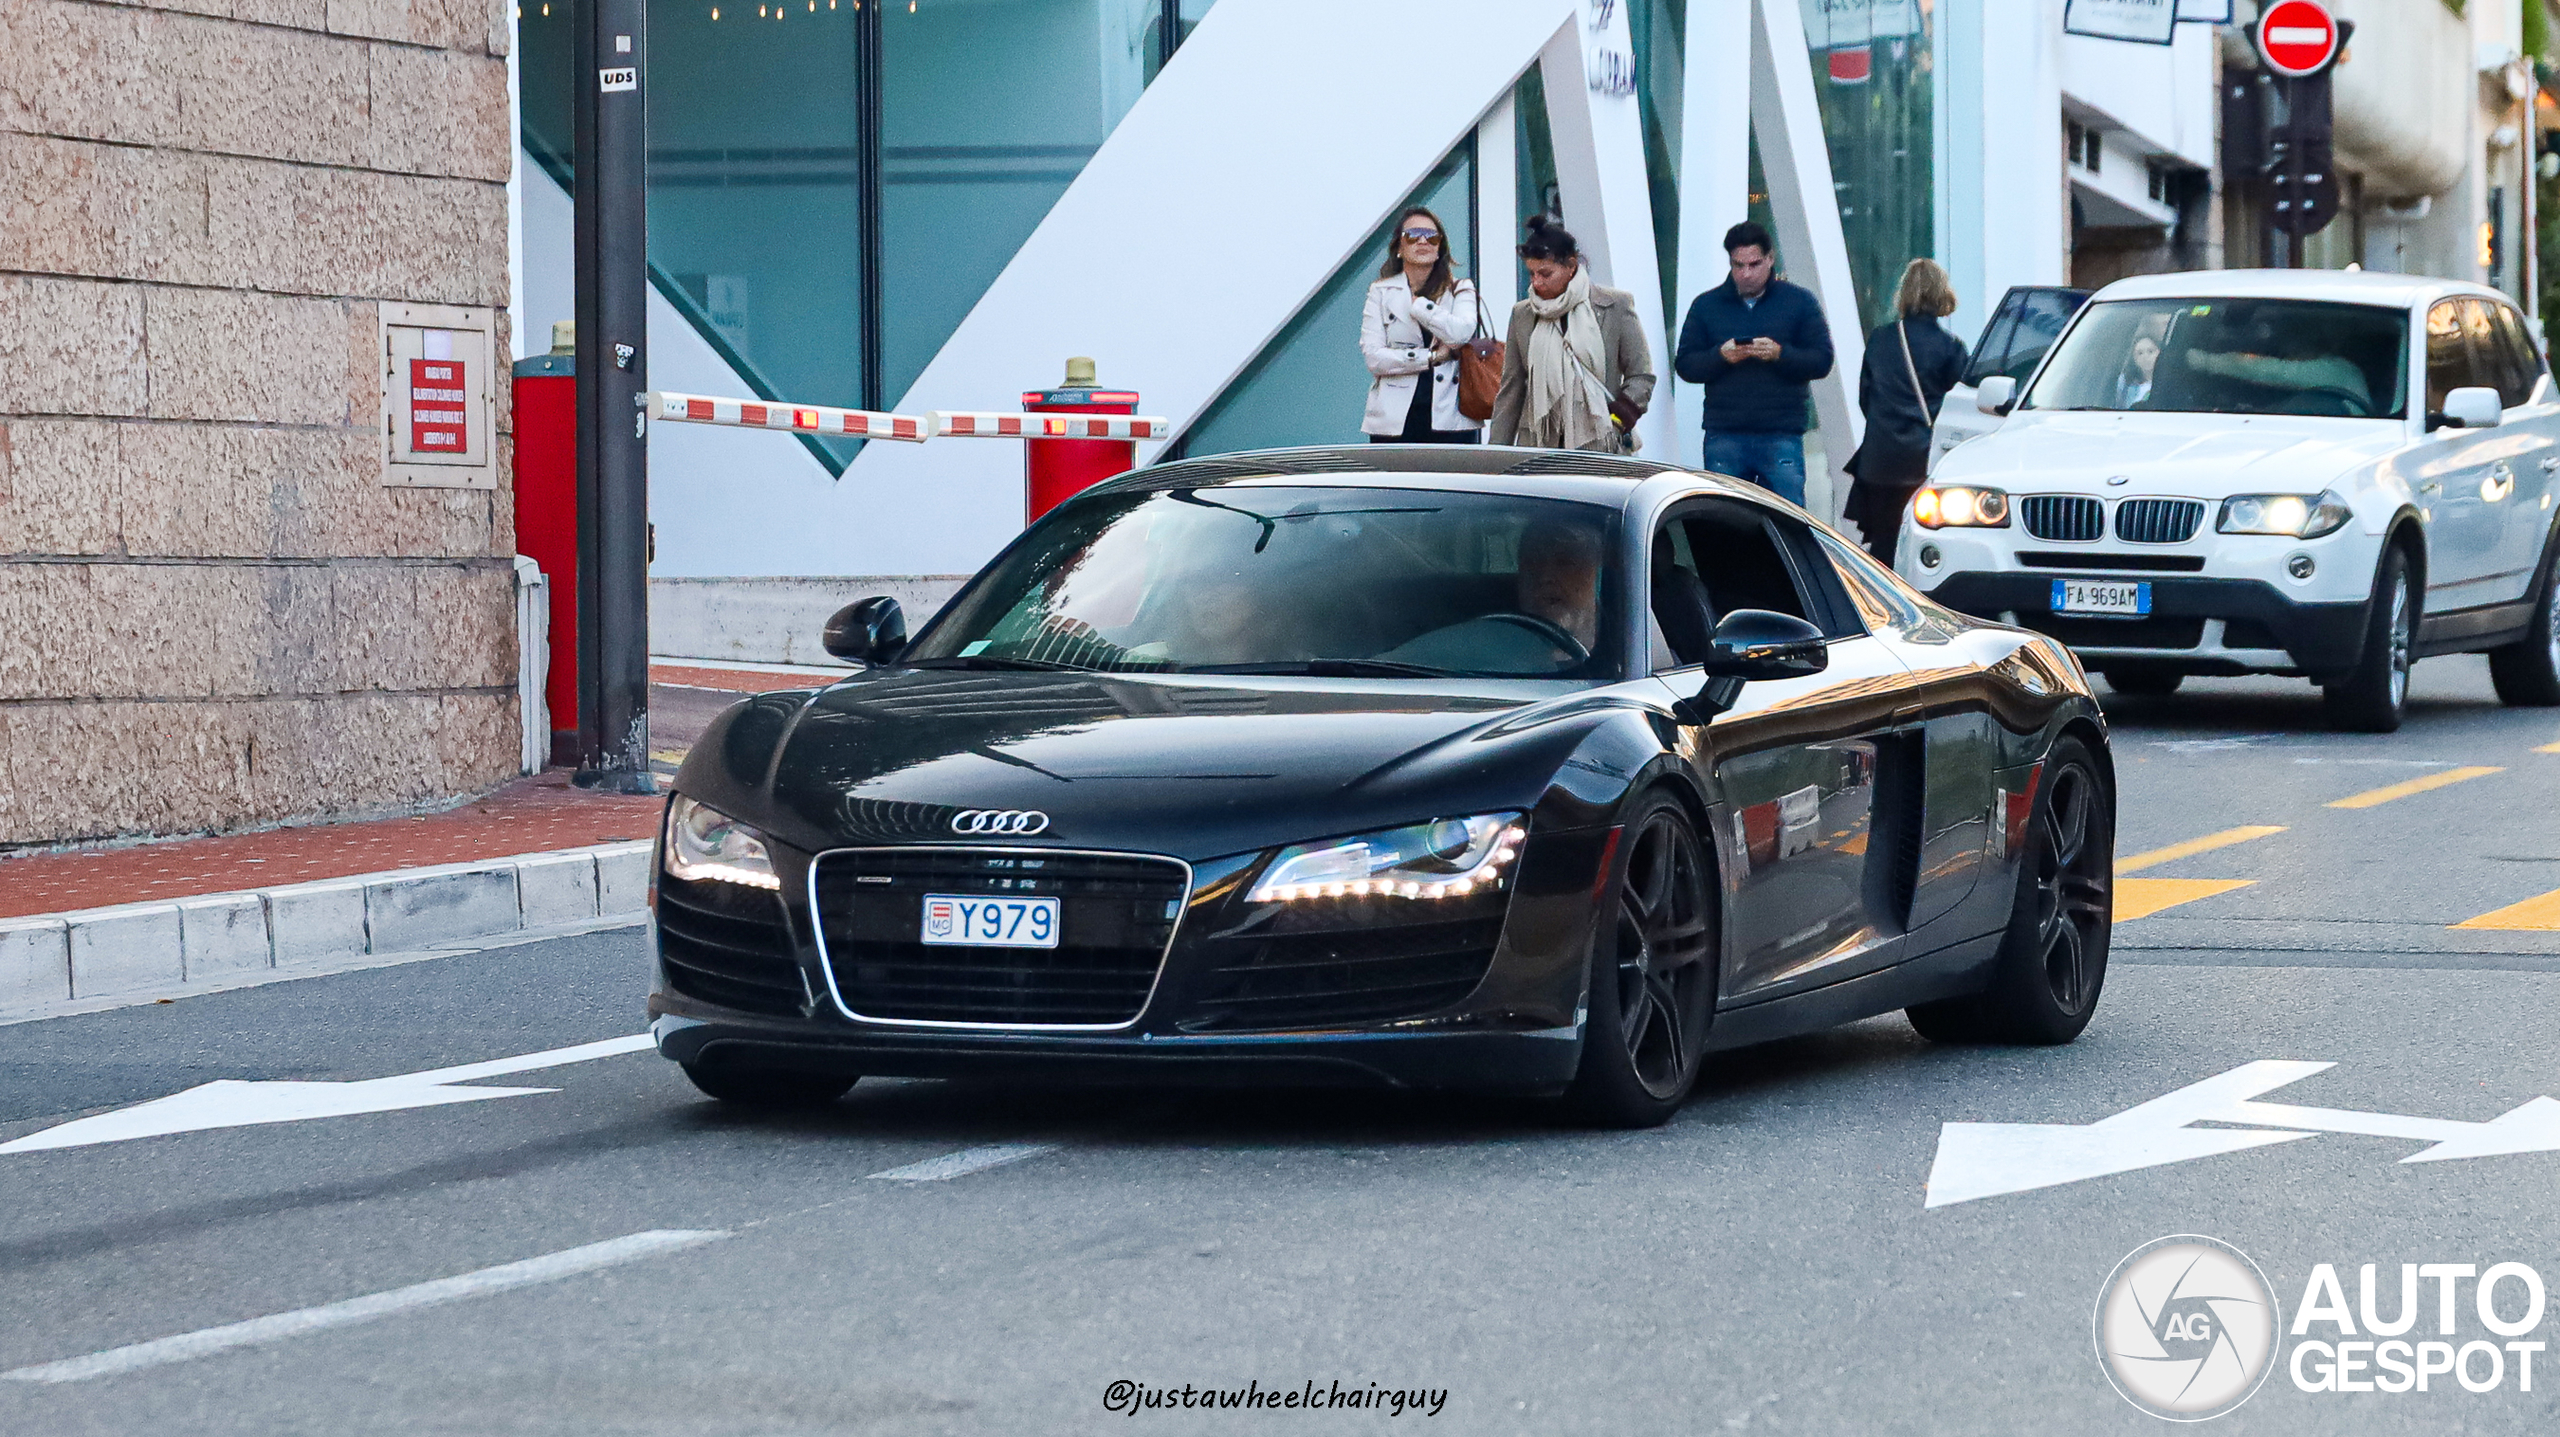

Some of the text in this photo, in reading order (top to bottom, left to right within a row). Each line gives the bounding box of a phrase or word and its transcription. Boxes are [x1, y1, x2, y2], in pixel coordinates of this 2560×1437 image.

[604, 71, 633, 85] UDS
[2066, 586, 2137, 606] FA 969AM
[932, 918, 950, 930] MC
[959, 902, 1051, 940] Y979
